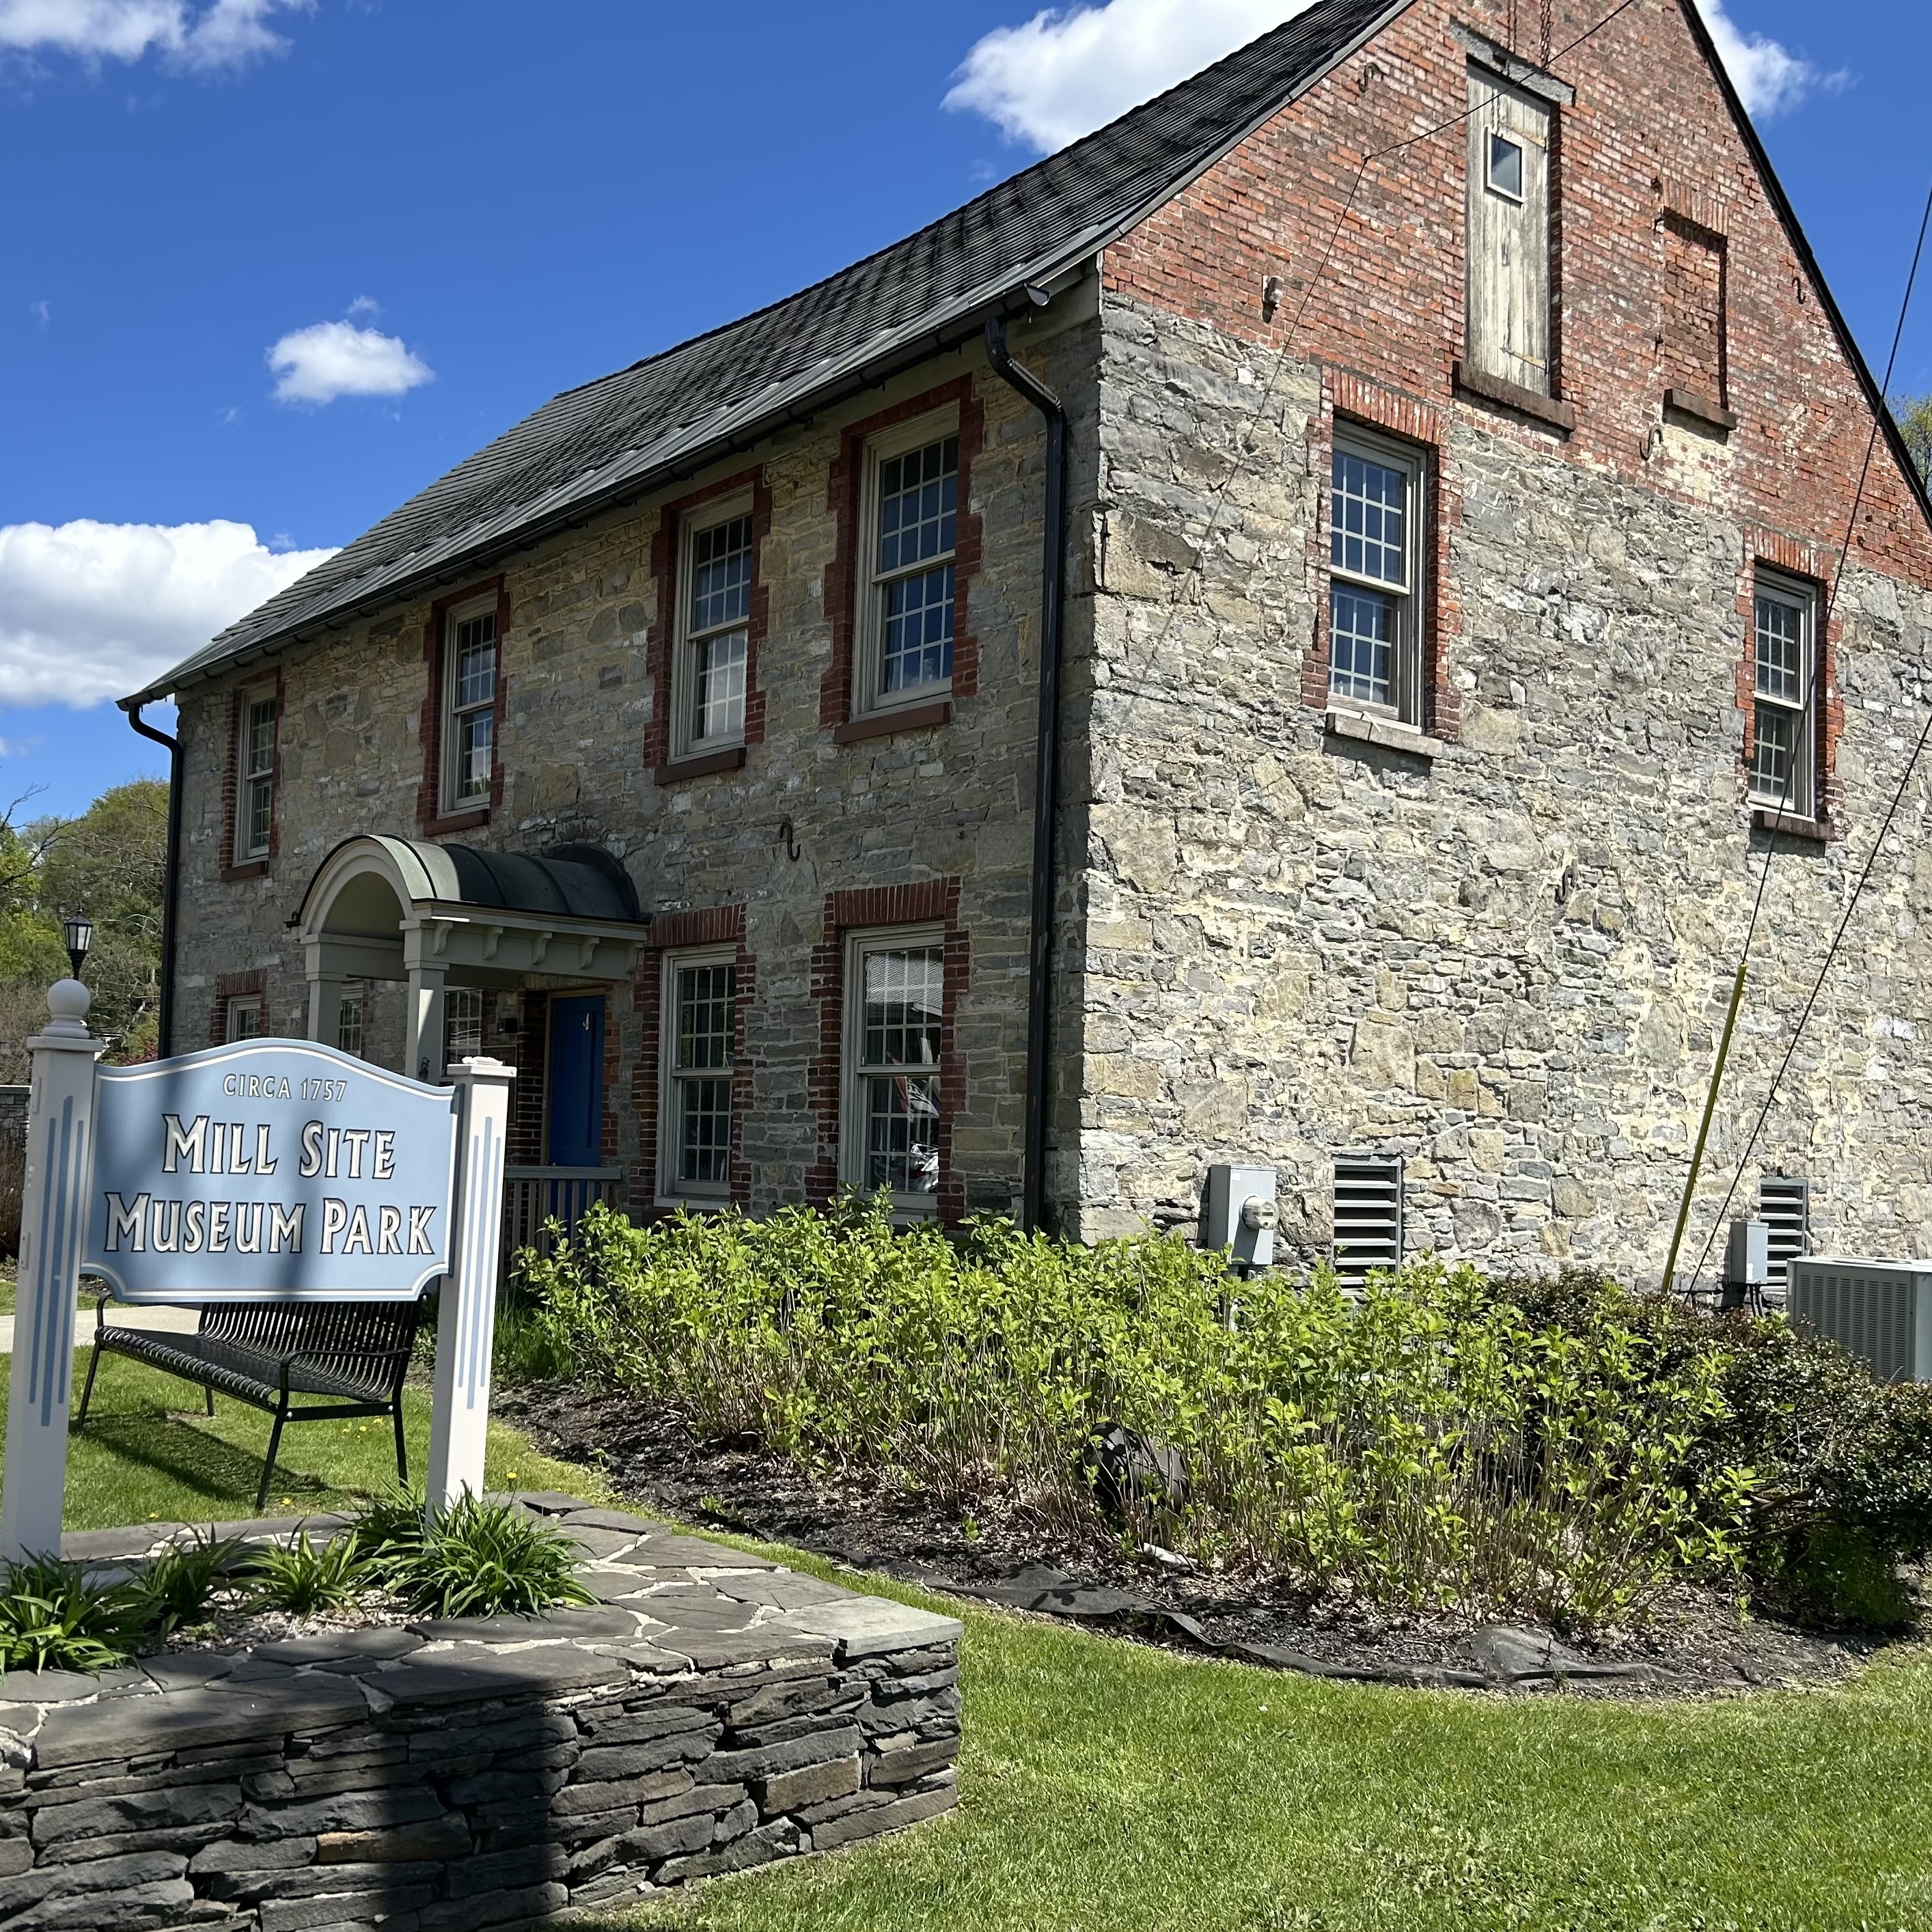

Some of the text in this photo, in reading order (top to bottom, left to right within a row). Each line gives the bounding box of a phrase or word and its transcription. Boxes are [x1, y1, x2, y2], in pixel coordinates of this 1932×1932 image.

[223, 1074, 348, 1101] CIRCA 1757
[162, 1114, 396, 1178] MILL SITE
[104, 1191, 437, 1254] MUSEUM PARK
